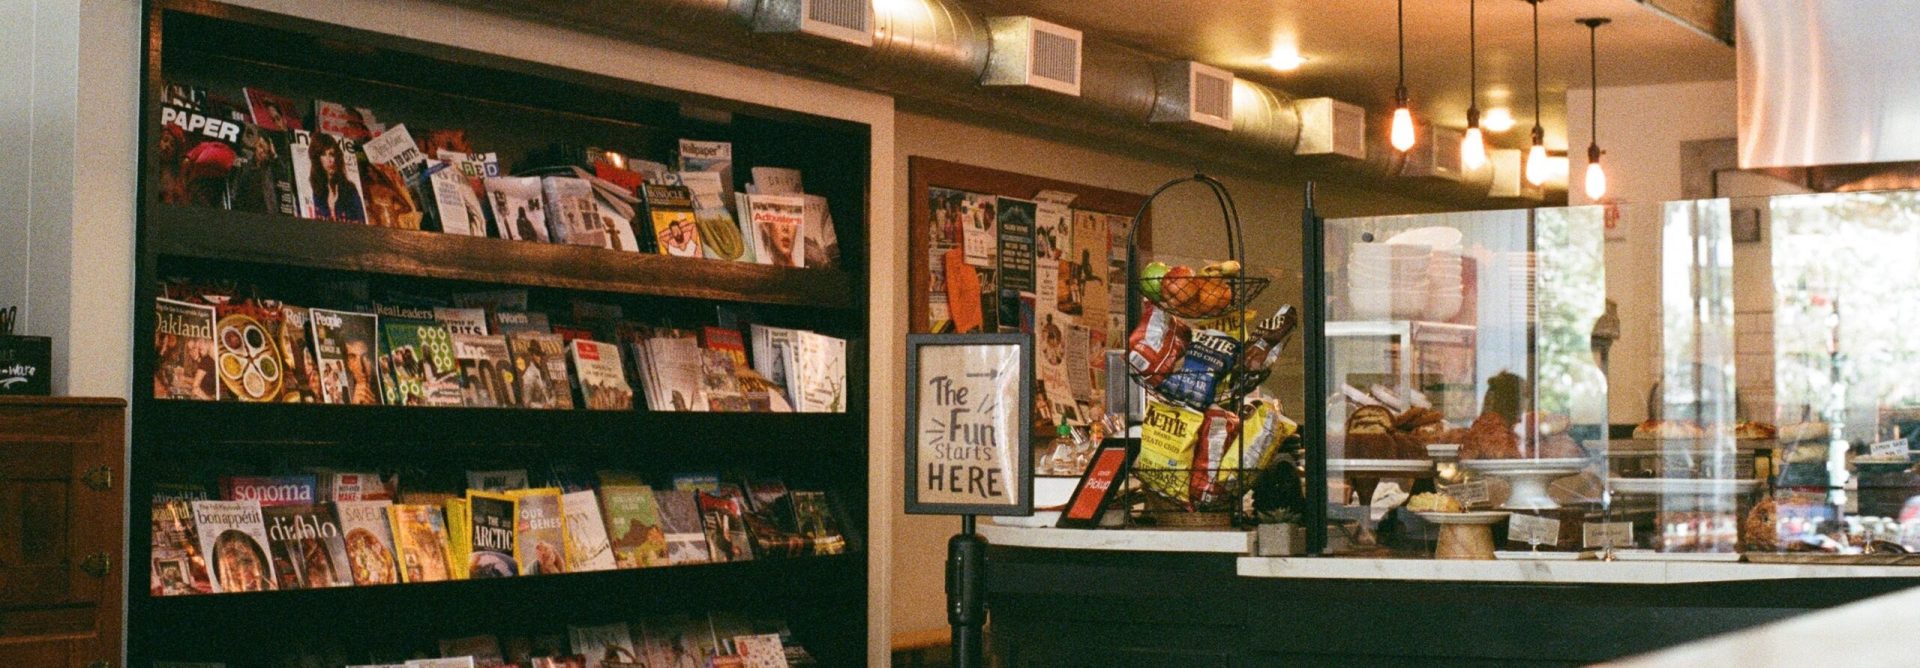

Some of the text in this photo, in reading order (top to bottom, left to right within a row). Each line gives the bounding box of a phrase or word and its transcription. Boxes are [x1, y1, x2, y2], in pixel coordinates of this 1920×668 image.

[161, 106, 240, 143] PAPER
[315, 312, 343, 330] People
[499, 313, 528, 324] Worth
[930, 376, 969, 406] The
[949, 408, 997, 447] Fun
[235, 484, 312, 501] sonoma
[928, 463, 1003, 498] HERE
[521, 509, 544, 518] OUR
[530, 518, 561, 530] GENES
[270, 515, 336, 541] diablo
[474, 525, 513, 550] ARCTIC
